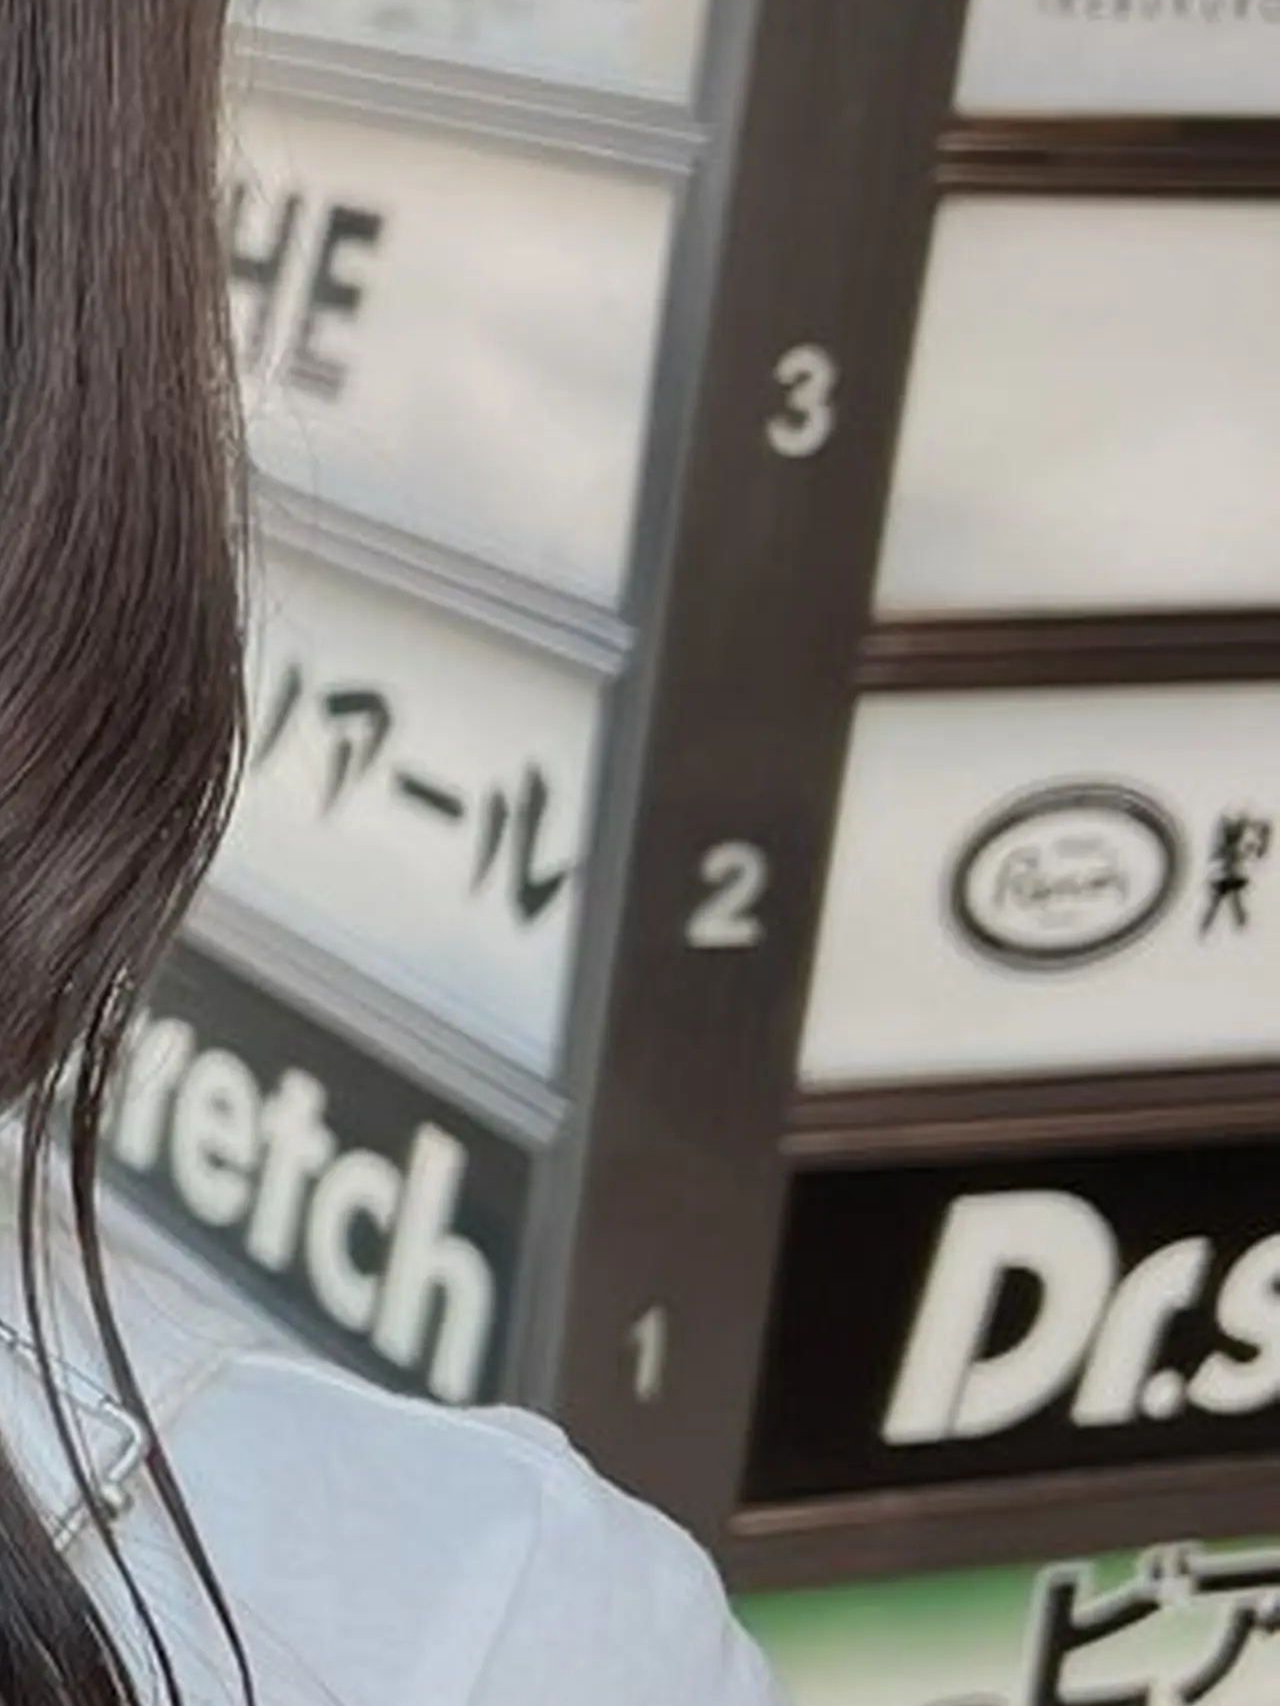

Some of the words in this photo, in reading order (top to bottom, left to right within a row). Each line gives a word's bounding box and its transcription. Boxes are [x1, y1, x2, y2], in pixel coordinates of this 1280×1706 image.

[766, 339, 838, 461] 3
[684, 839, 764, 951] 2
[626, 1303, 670, 1405] 1
